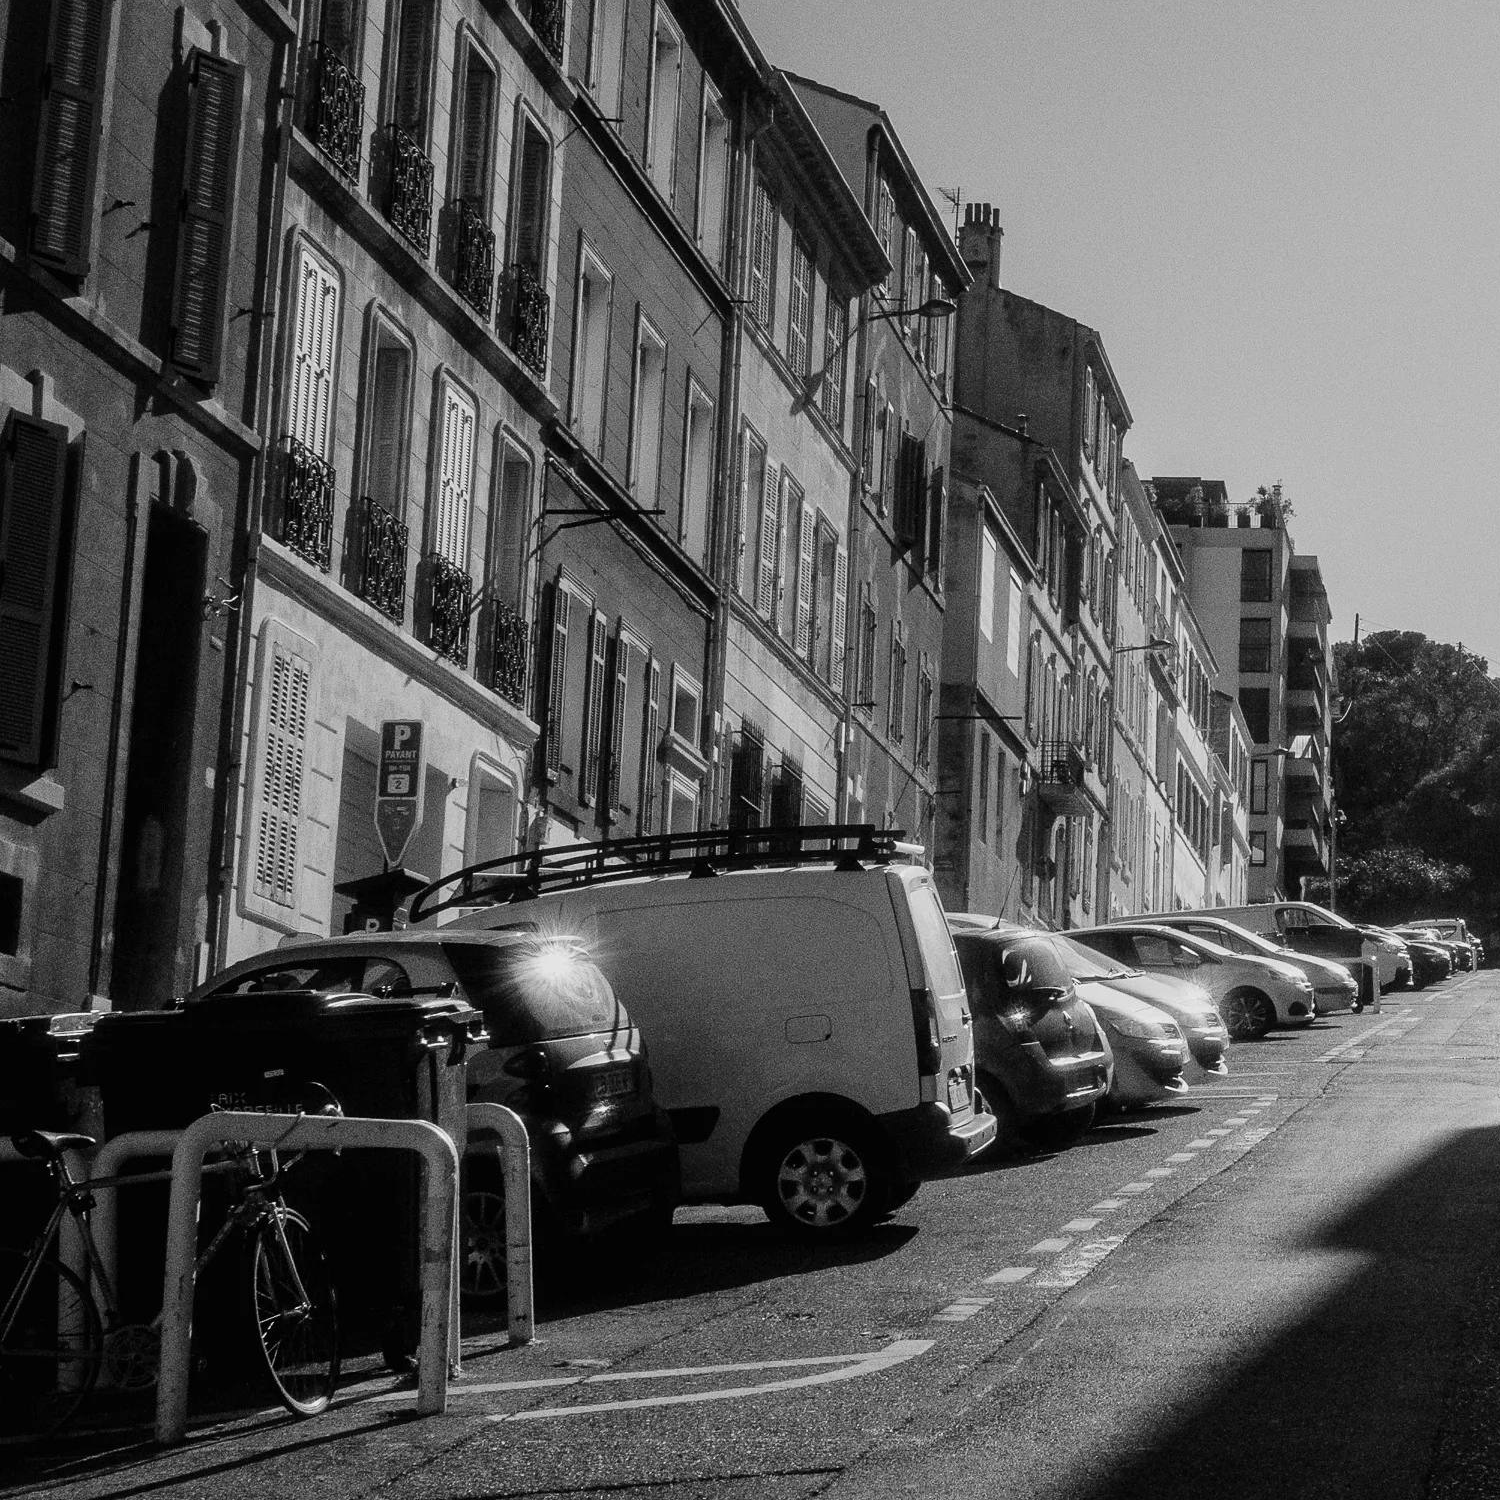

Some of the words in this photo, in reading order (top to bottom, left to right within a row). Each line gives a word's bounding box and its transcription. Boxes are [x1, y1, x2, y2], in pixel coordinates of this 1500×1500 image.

[394, 724, 411, 750] P
[385, 750, 417, 759] PAYANT
[395, 780, 402, 790] 2
[219, 1092, 246, 1105] AIX
